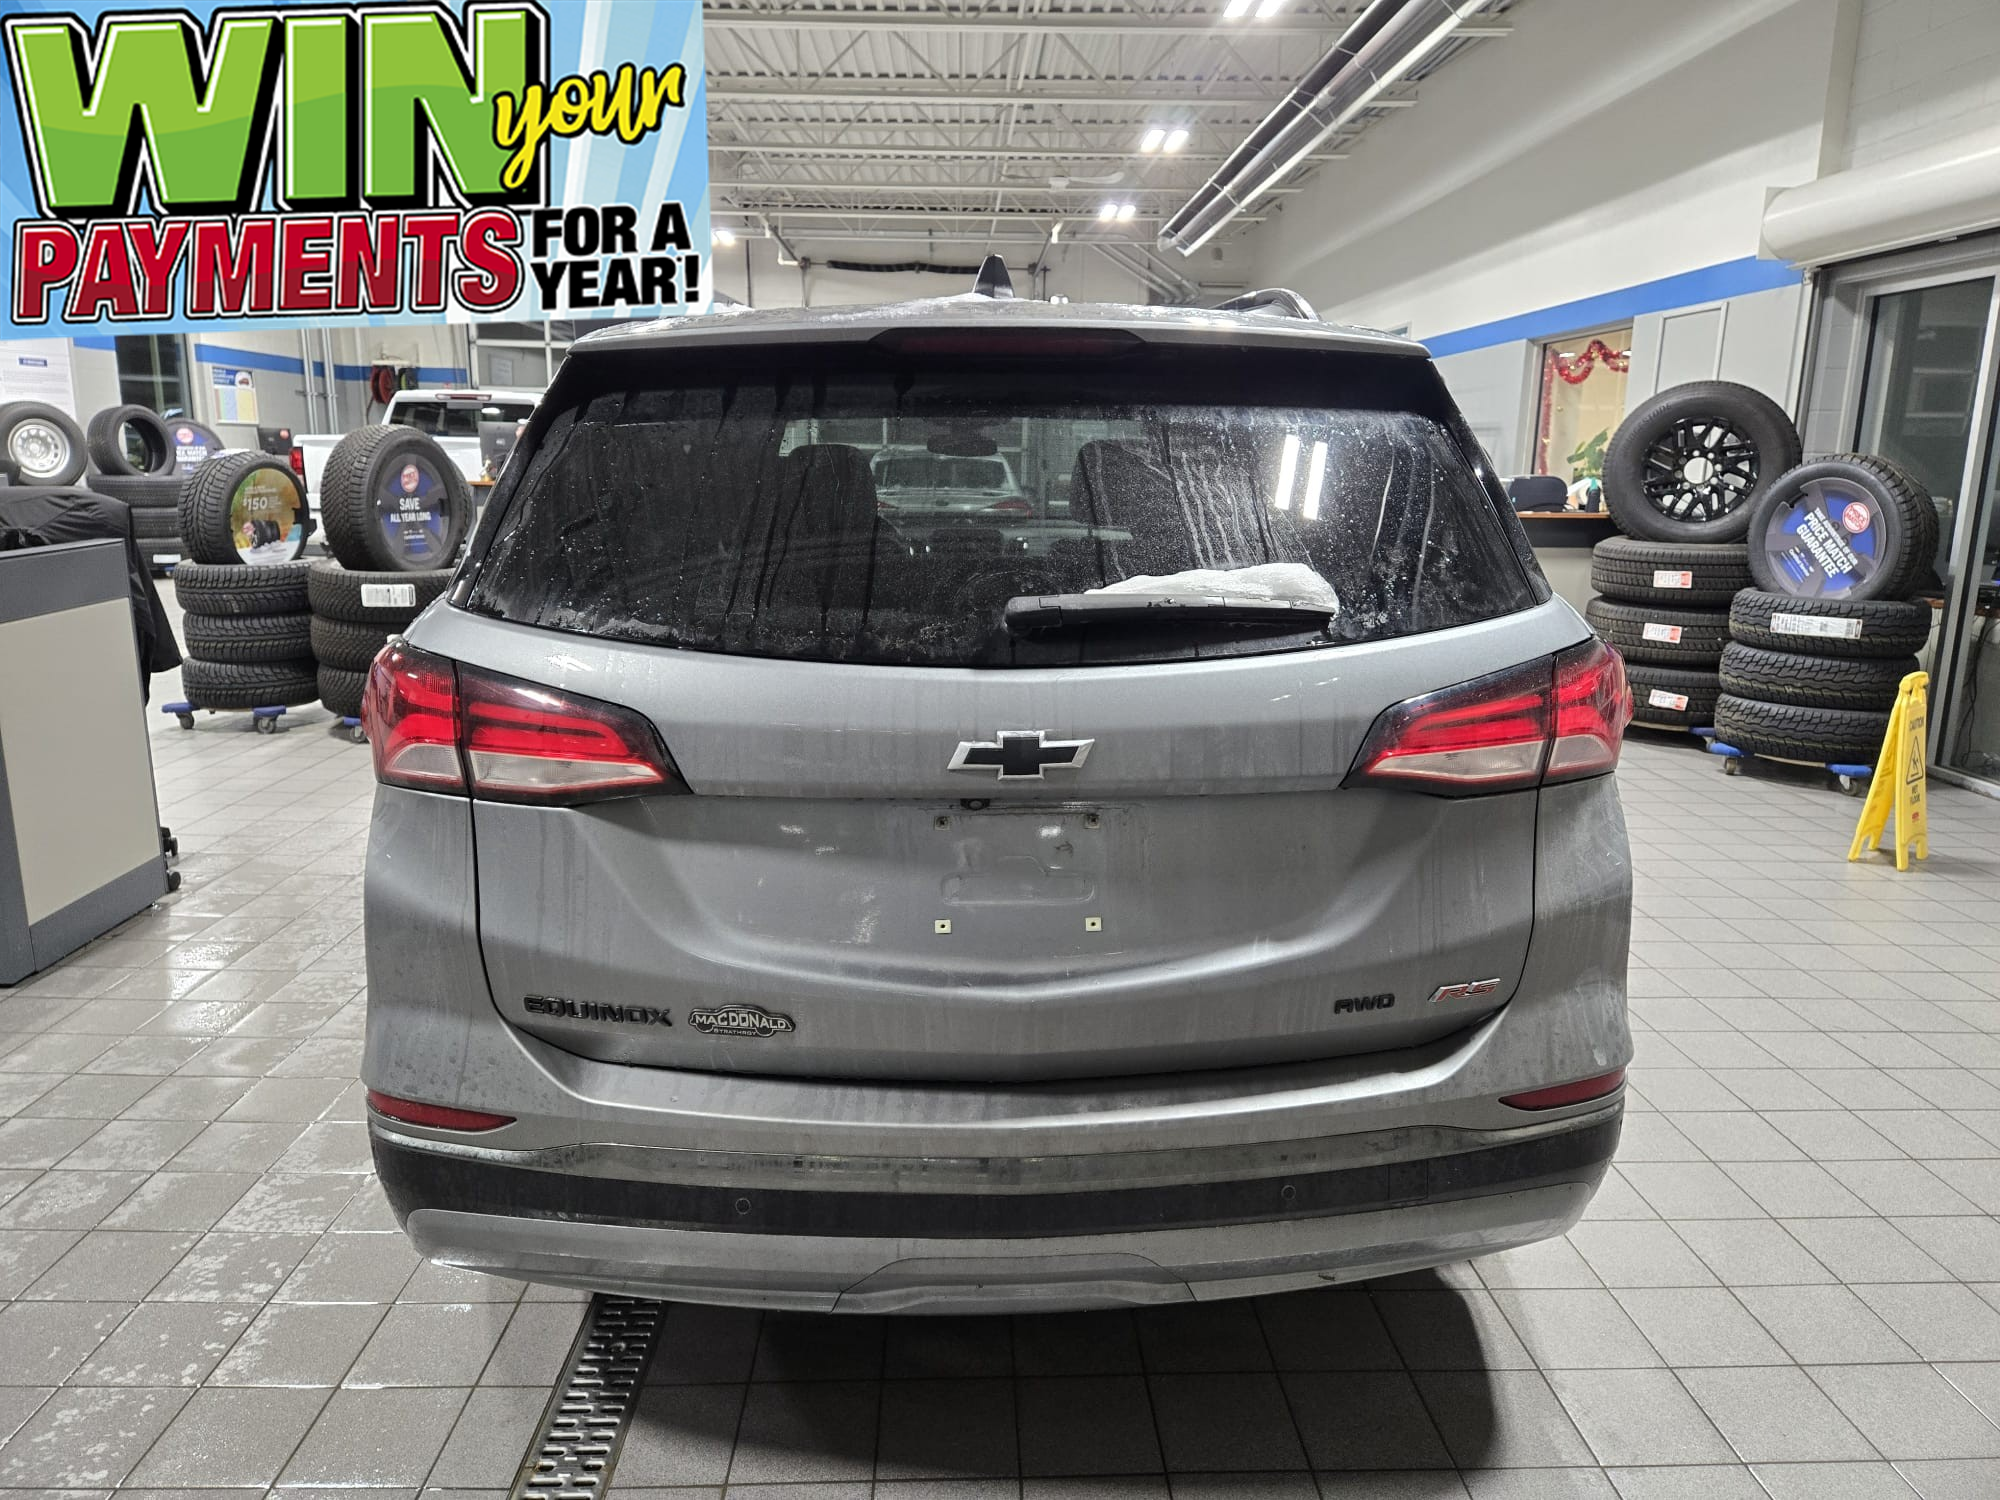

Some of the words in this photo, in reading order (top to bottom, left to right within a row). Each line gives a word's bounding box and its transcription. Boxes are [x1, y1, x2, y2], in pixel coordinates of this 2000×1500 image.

[399, 497, 421, 511] SAVE
[1796, 523, 1840, 578] GUARANTEE
[1803, 511, 1829, 542] PRICE
[1822, 538, 1854, 575] MATCH
[1428, 977, 1500, 1003] RS
[523, 994, 672, 1028] EQUINOX
[1334, 993, 1396, 1015] AWD
[695, 1011, 786, 1030] MACDONALD
